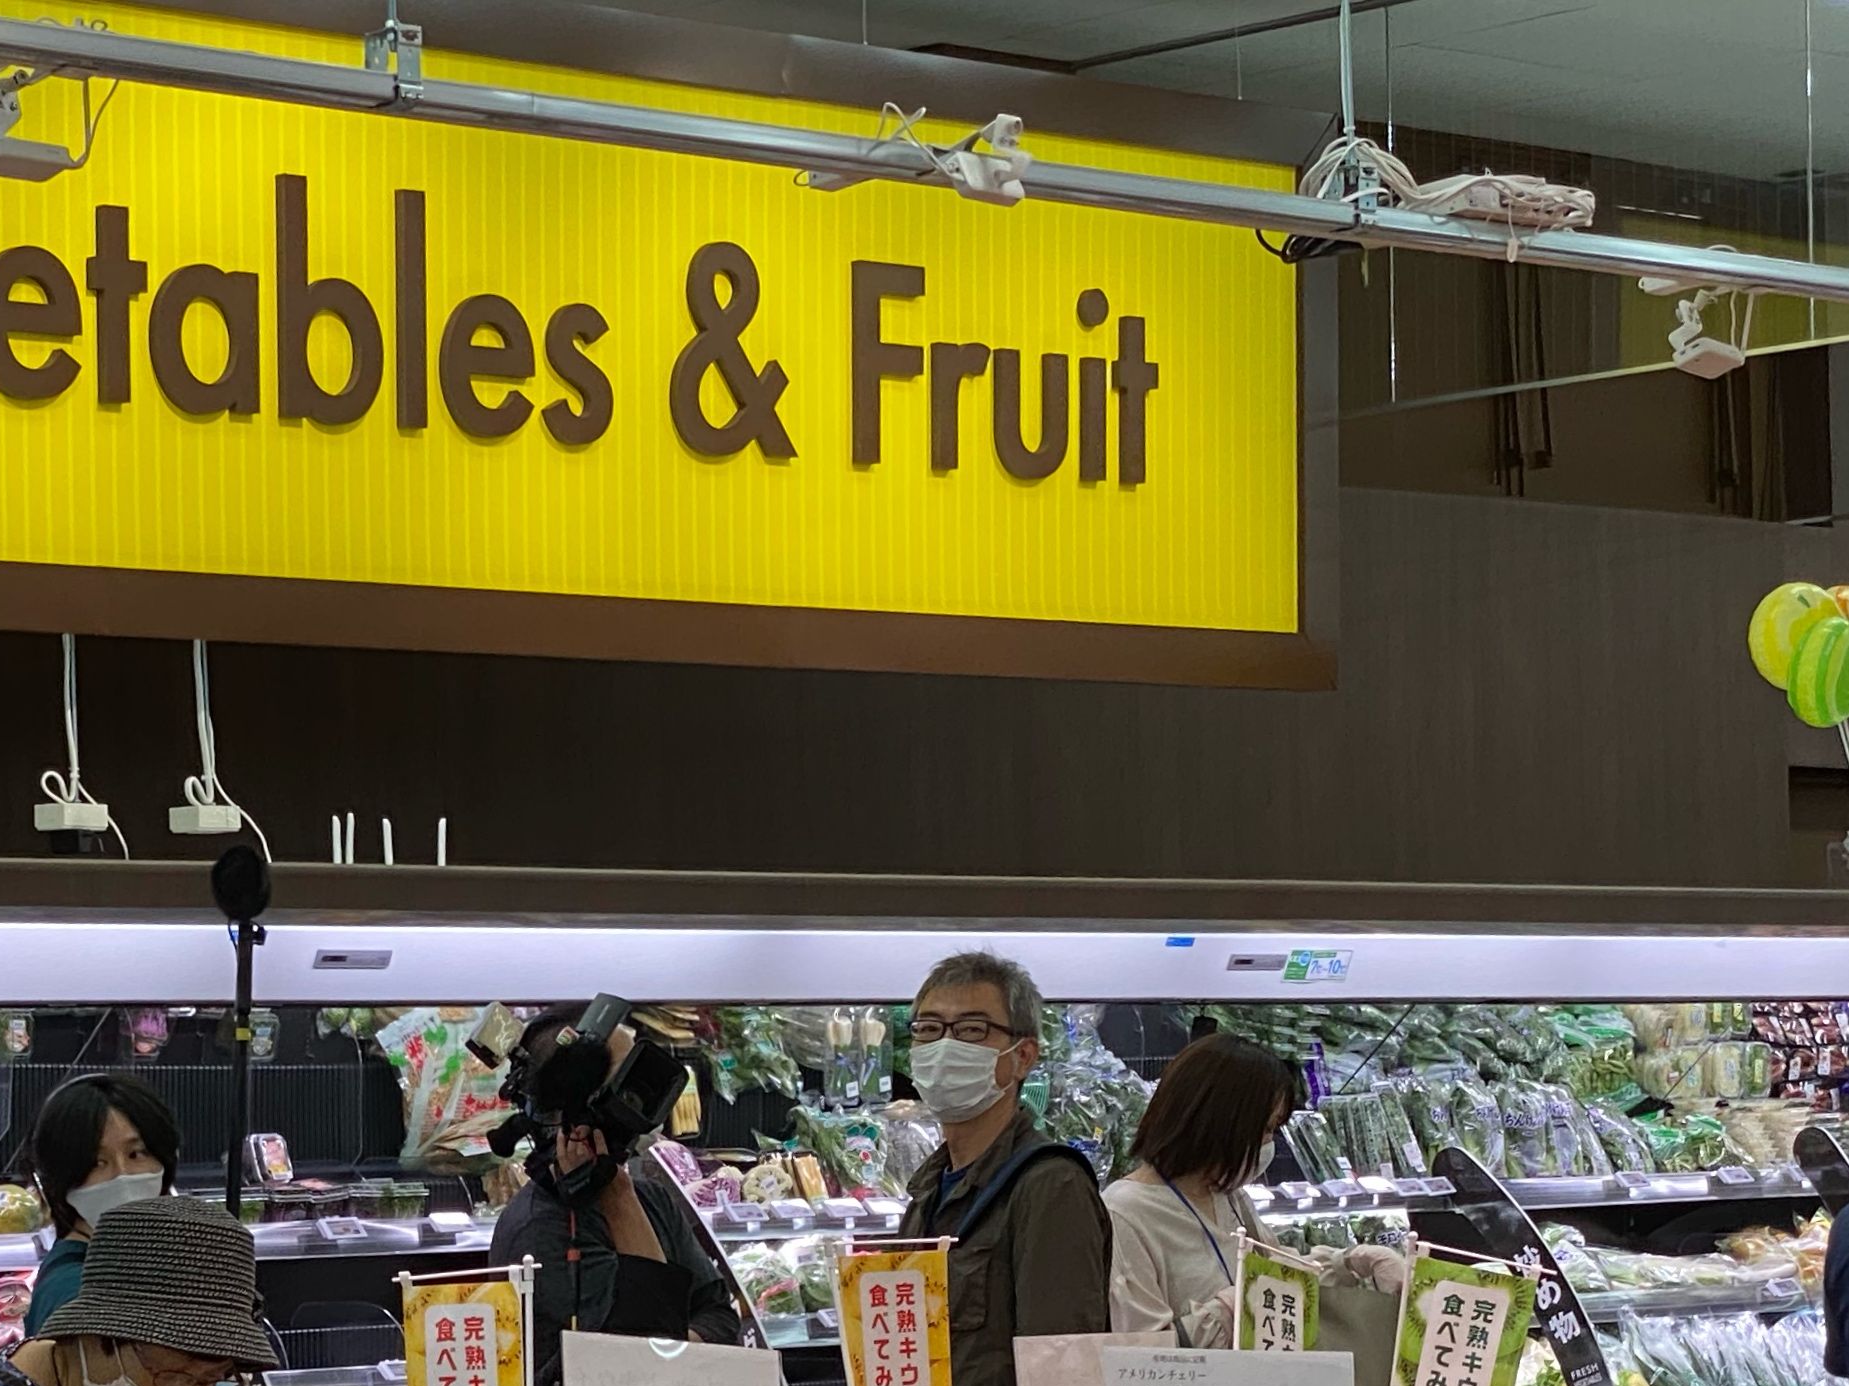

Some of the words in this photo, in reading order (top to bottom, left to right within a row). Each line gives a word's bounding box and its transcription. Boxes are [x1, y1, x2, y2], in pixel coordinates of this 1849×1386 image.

[668, 238, 798, 462] &
[849, 261, 1161, 490] Fruit
[1118, 1368, 1207, 1382] アメリカンチェリー
[1570, 1362, 1600, 1381] FRESH
